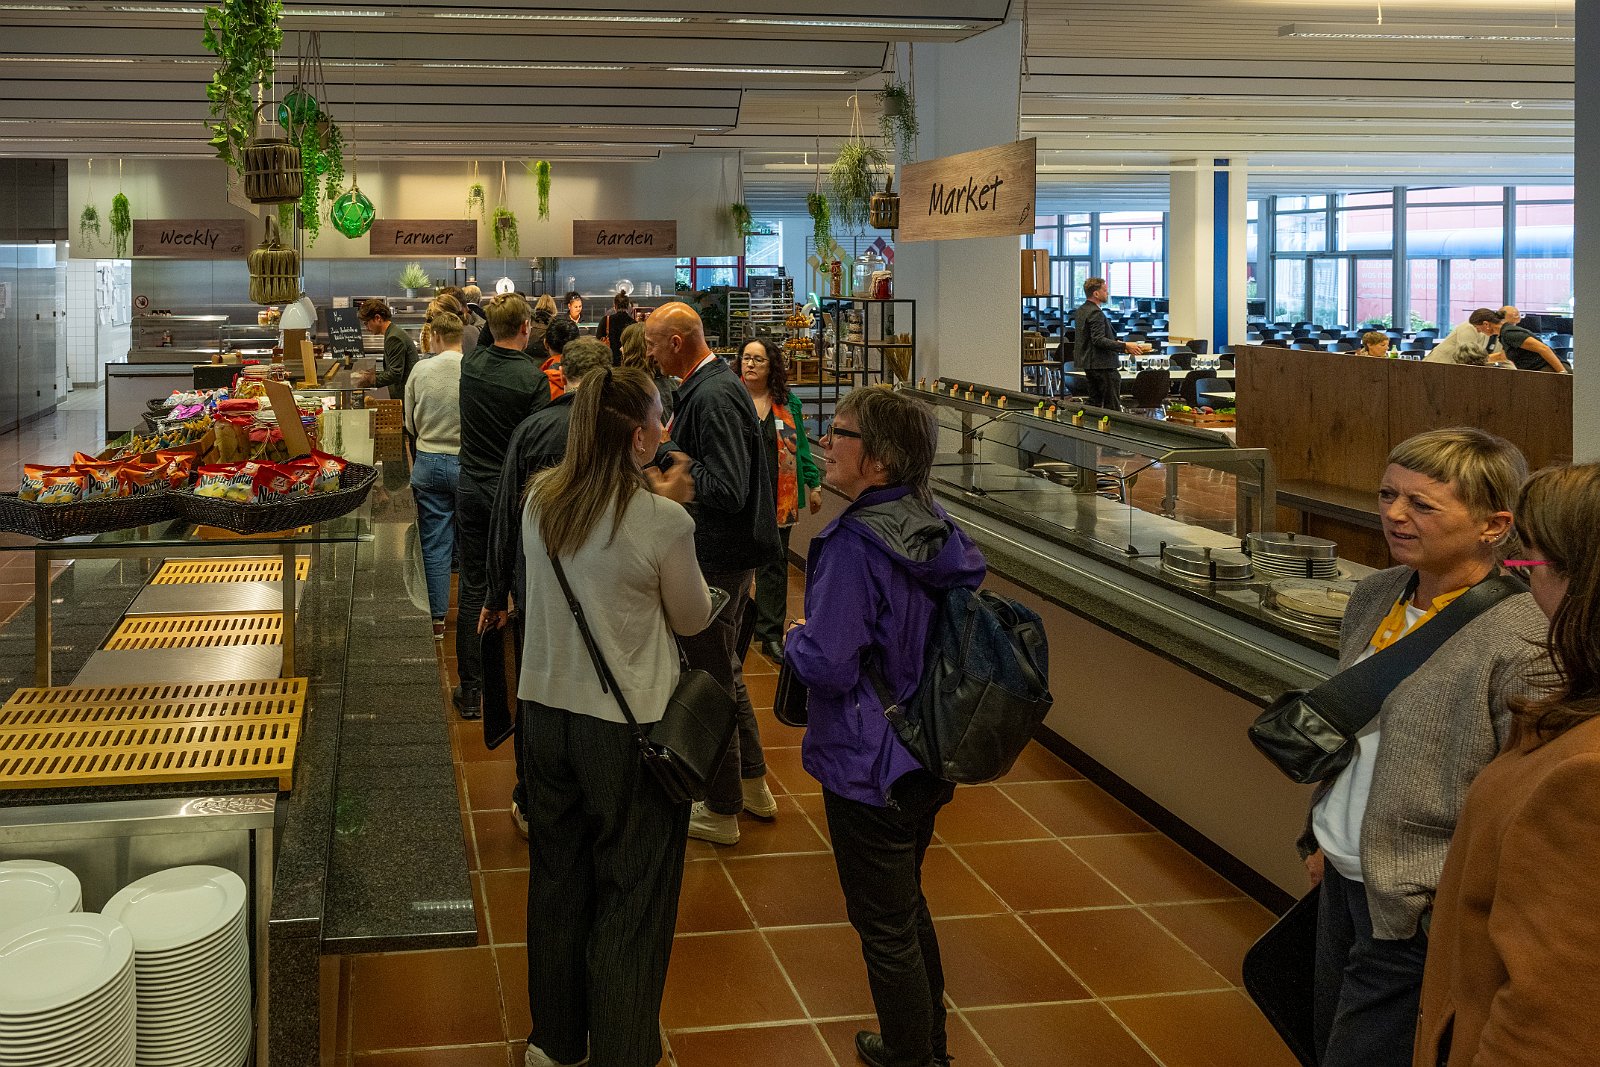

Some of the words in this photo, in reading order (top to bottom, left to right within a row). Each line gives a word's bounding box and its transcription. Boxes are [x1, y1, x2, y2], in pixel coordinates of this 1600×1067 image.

[929, 175, 1003, 216] Market
[160, 229, 219, 250] Weekly
[395, 230, 453, 245] Farmer
[597, 230, 653, 246] Garden
